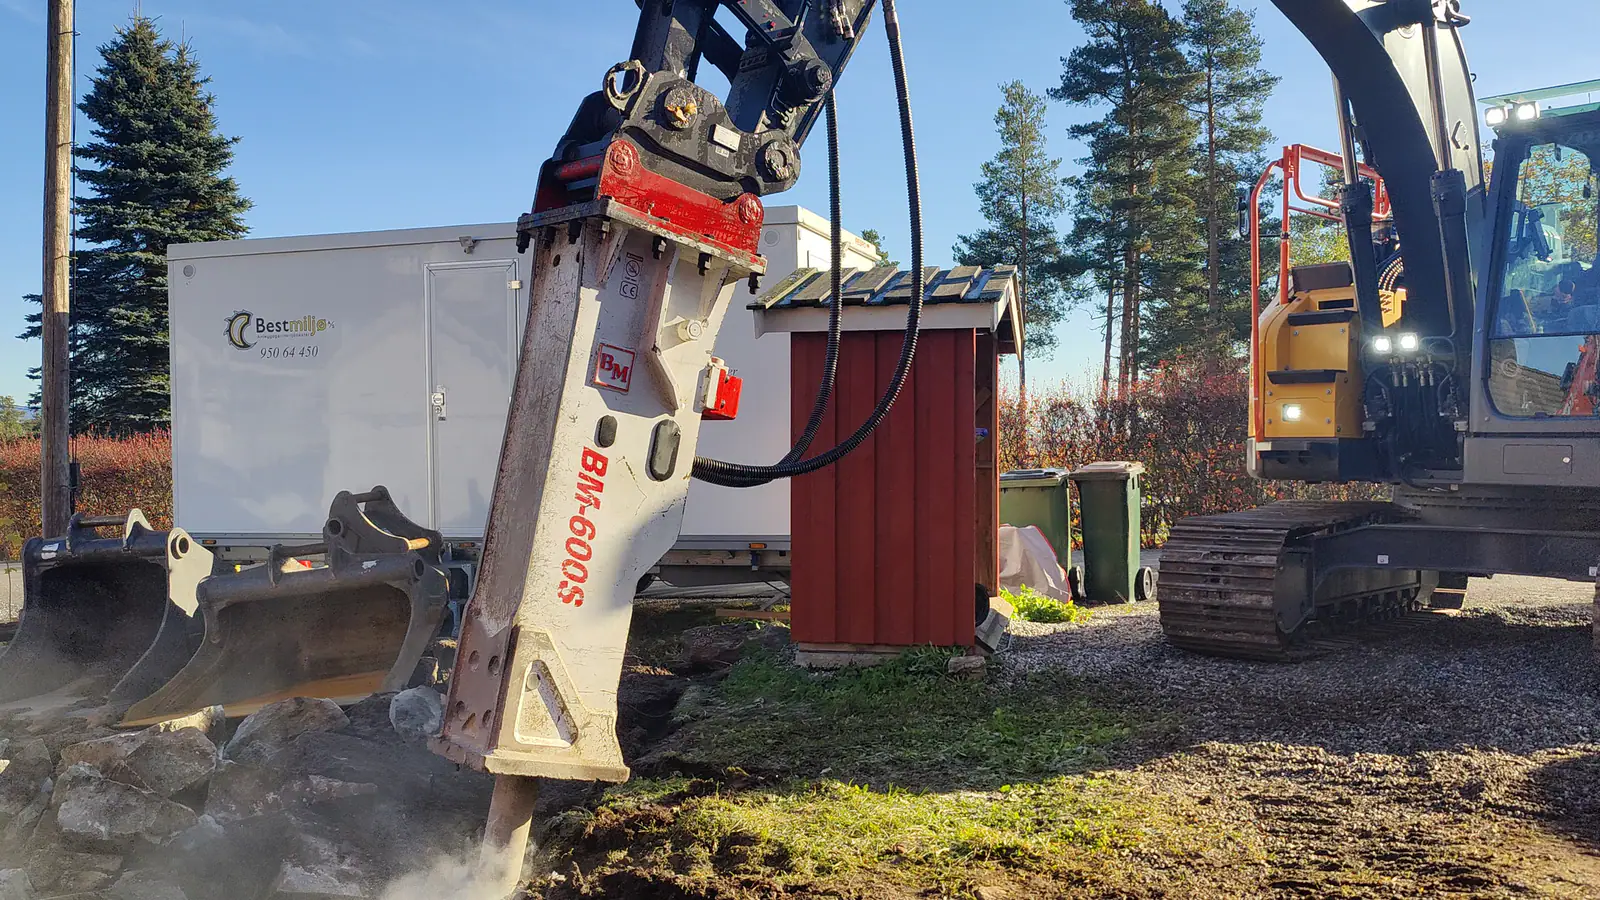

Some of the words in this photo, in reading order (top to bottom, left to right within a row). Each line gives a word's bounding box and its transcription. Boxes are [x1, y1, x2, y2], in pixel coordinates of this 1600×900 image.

[256, 315, 327, 336] Bestmiljø
[260, 347, 280, 359] 950
[282, 346, 296, 358] 64
[299, 345, 319, 358] 450
[600, 352, 630, 383] BM
[557, 446, 609, 608] BM-600S
